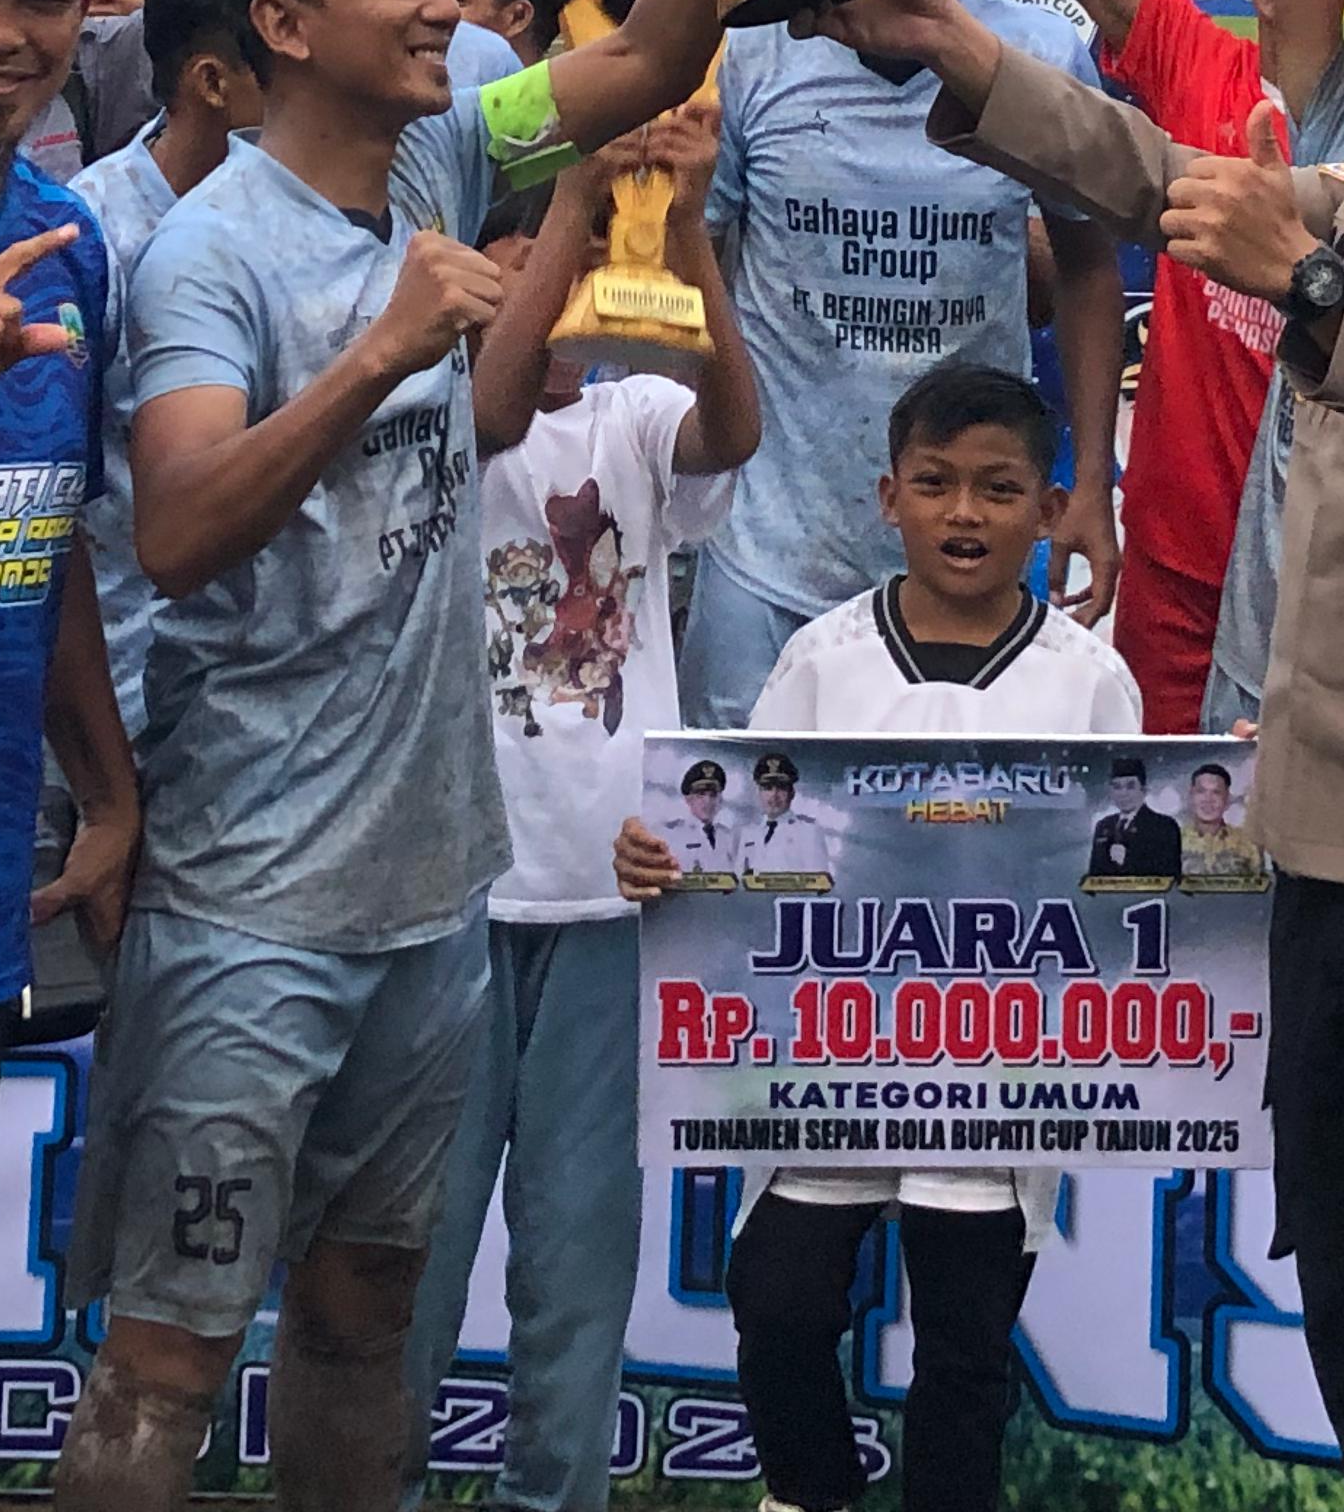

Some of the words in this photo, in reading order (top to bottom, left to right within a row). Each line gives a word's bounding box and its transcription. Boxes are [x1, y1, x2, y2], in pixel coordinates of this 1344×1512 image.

[785, 198, 898, 244] Cahaya
[910, 204, 996, 245] Ujung
[842, 240, 938, 285] Group
[823, 292, 931, 326] BERINGIN
[938, 295, 986, 325] JAYA
[835, 323, 941, 354] PERKASA
[848, 761, 1076, 796] KOTABARU
[907, 797, 1013, 825] HEBAT
[750, 898, 1096, 976] JUARA
[1123, 898, 1171, 976] 1
[791, 980, 1262, 1083] 10.000.000,-
[769, 1081, 987, 1110] KATEGORI
[1000, 1082, 1141, 1110] UMUM
[671, 1119, 802, 1151] TURNAMEN
[805, 1119, 879, 1151] SEPAK
[885, 1119, 946, 1151] BOLA
[951, 1119, 1035, 1151] BUPATI
[1040, 1119, 1088, 1151] CUP
[1093, 1119, 1171, 1152] TAHUN
[1177, 1119, 1239, 1152] 2025
[175, 1176, 252, 1265] 25
